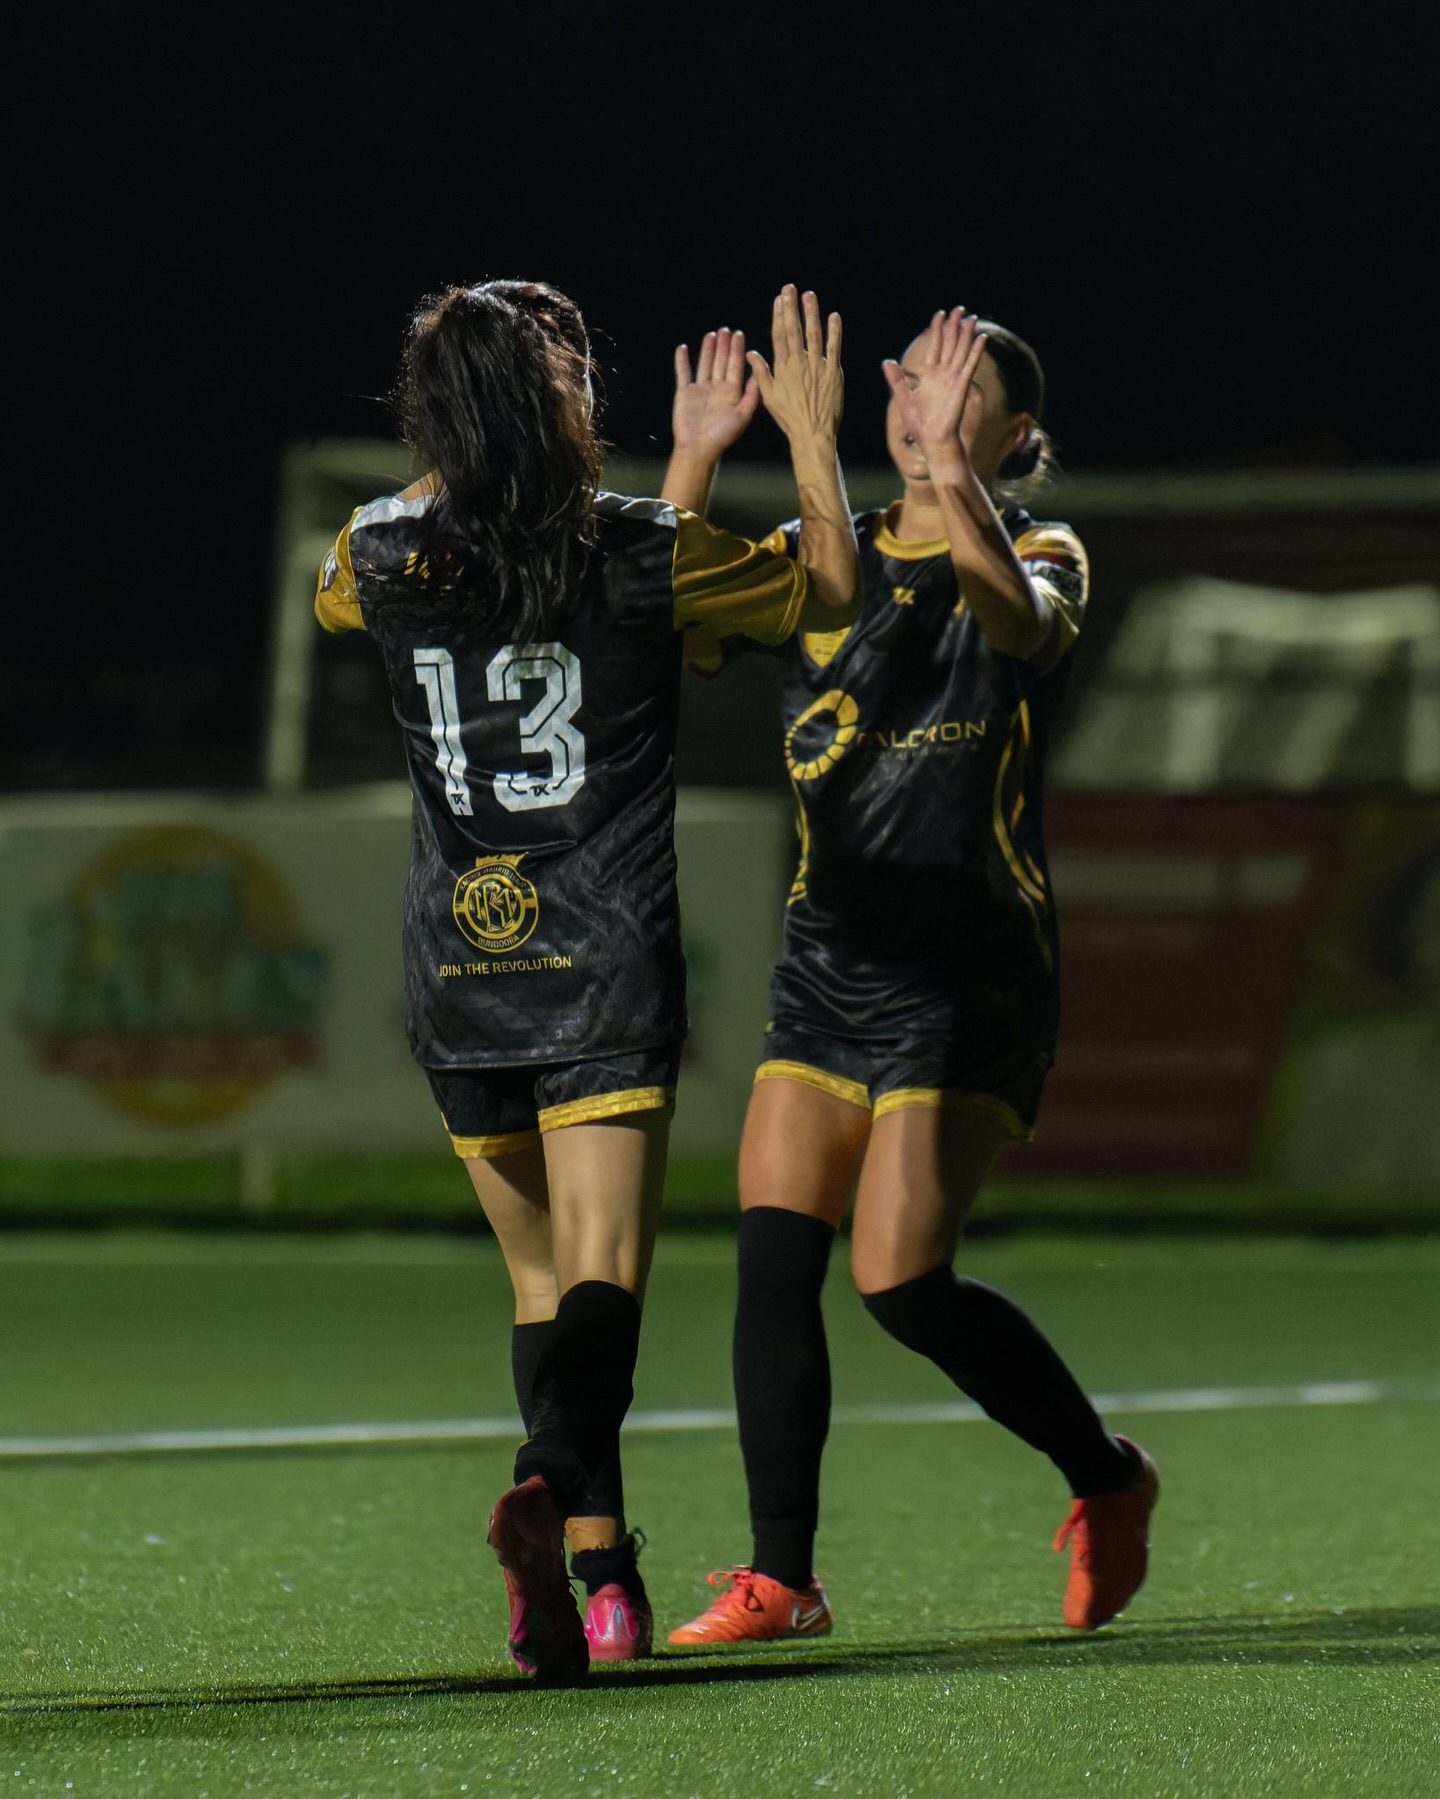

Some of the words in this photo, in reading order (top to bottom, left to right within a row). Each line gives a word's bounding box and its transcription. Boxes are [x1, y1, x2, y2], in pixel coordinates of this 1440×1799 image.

[413, 641, 585, 815] 13
[439, 963, 461, 978] JOIN
[464, 962, 490, 975] THE
[492, 955, 572, 974] REVOLUTION
